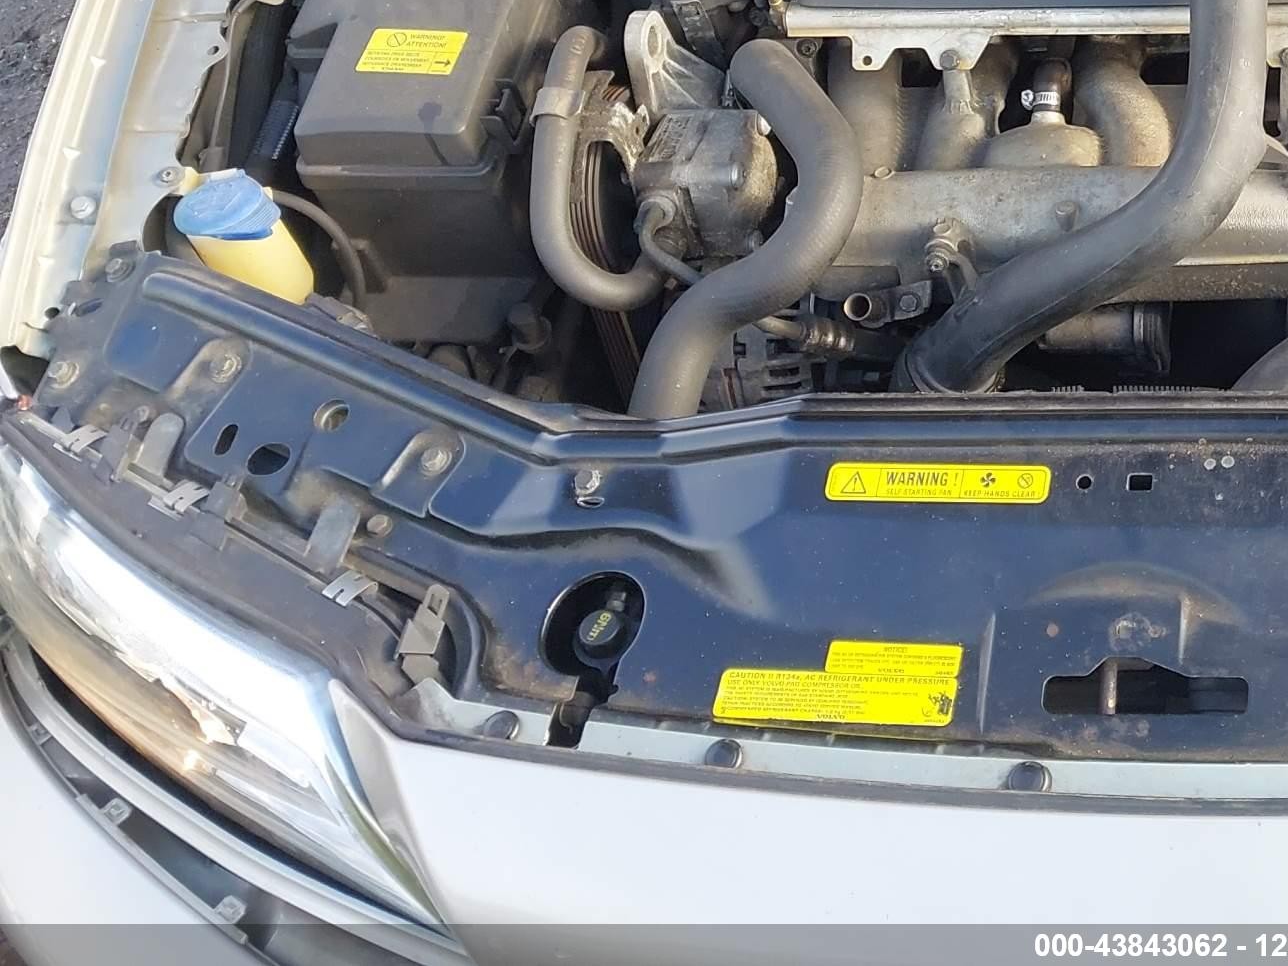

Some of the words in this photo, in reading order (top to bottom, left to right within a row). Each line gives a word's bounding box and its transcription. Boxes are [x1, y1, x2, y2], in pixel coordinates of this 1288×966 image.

[886, 471, 949, 486] WARNING
[801, 681, 849, 689] COMPRESSOR
[818, 674, 875, 683] REFRIGERANT
[876, 676, 905, 684] UNDER
[907, 677, 950, 685] PRESSURE
